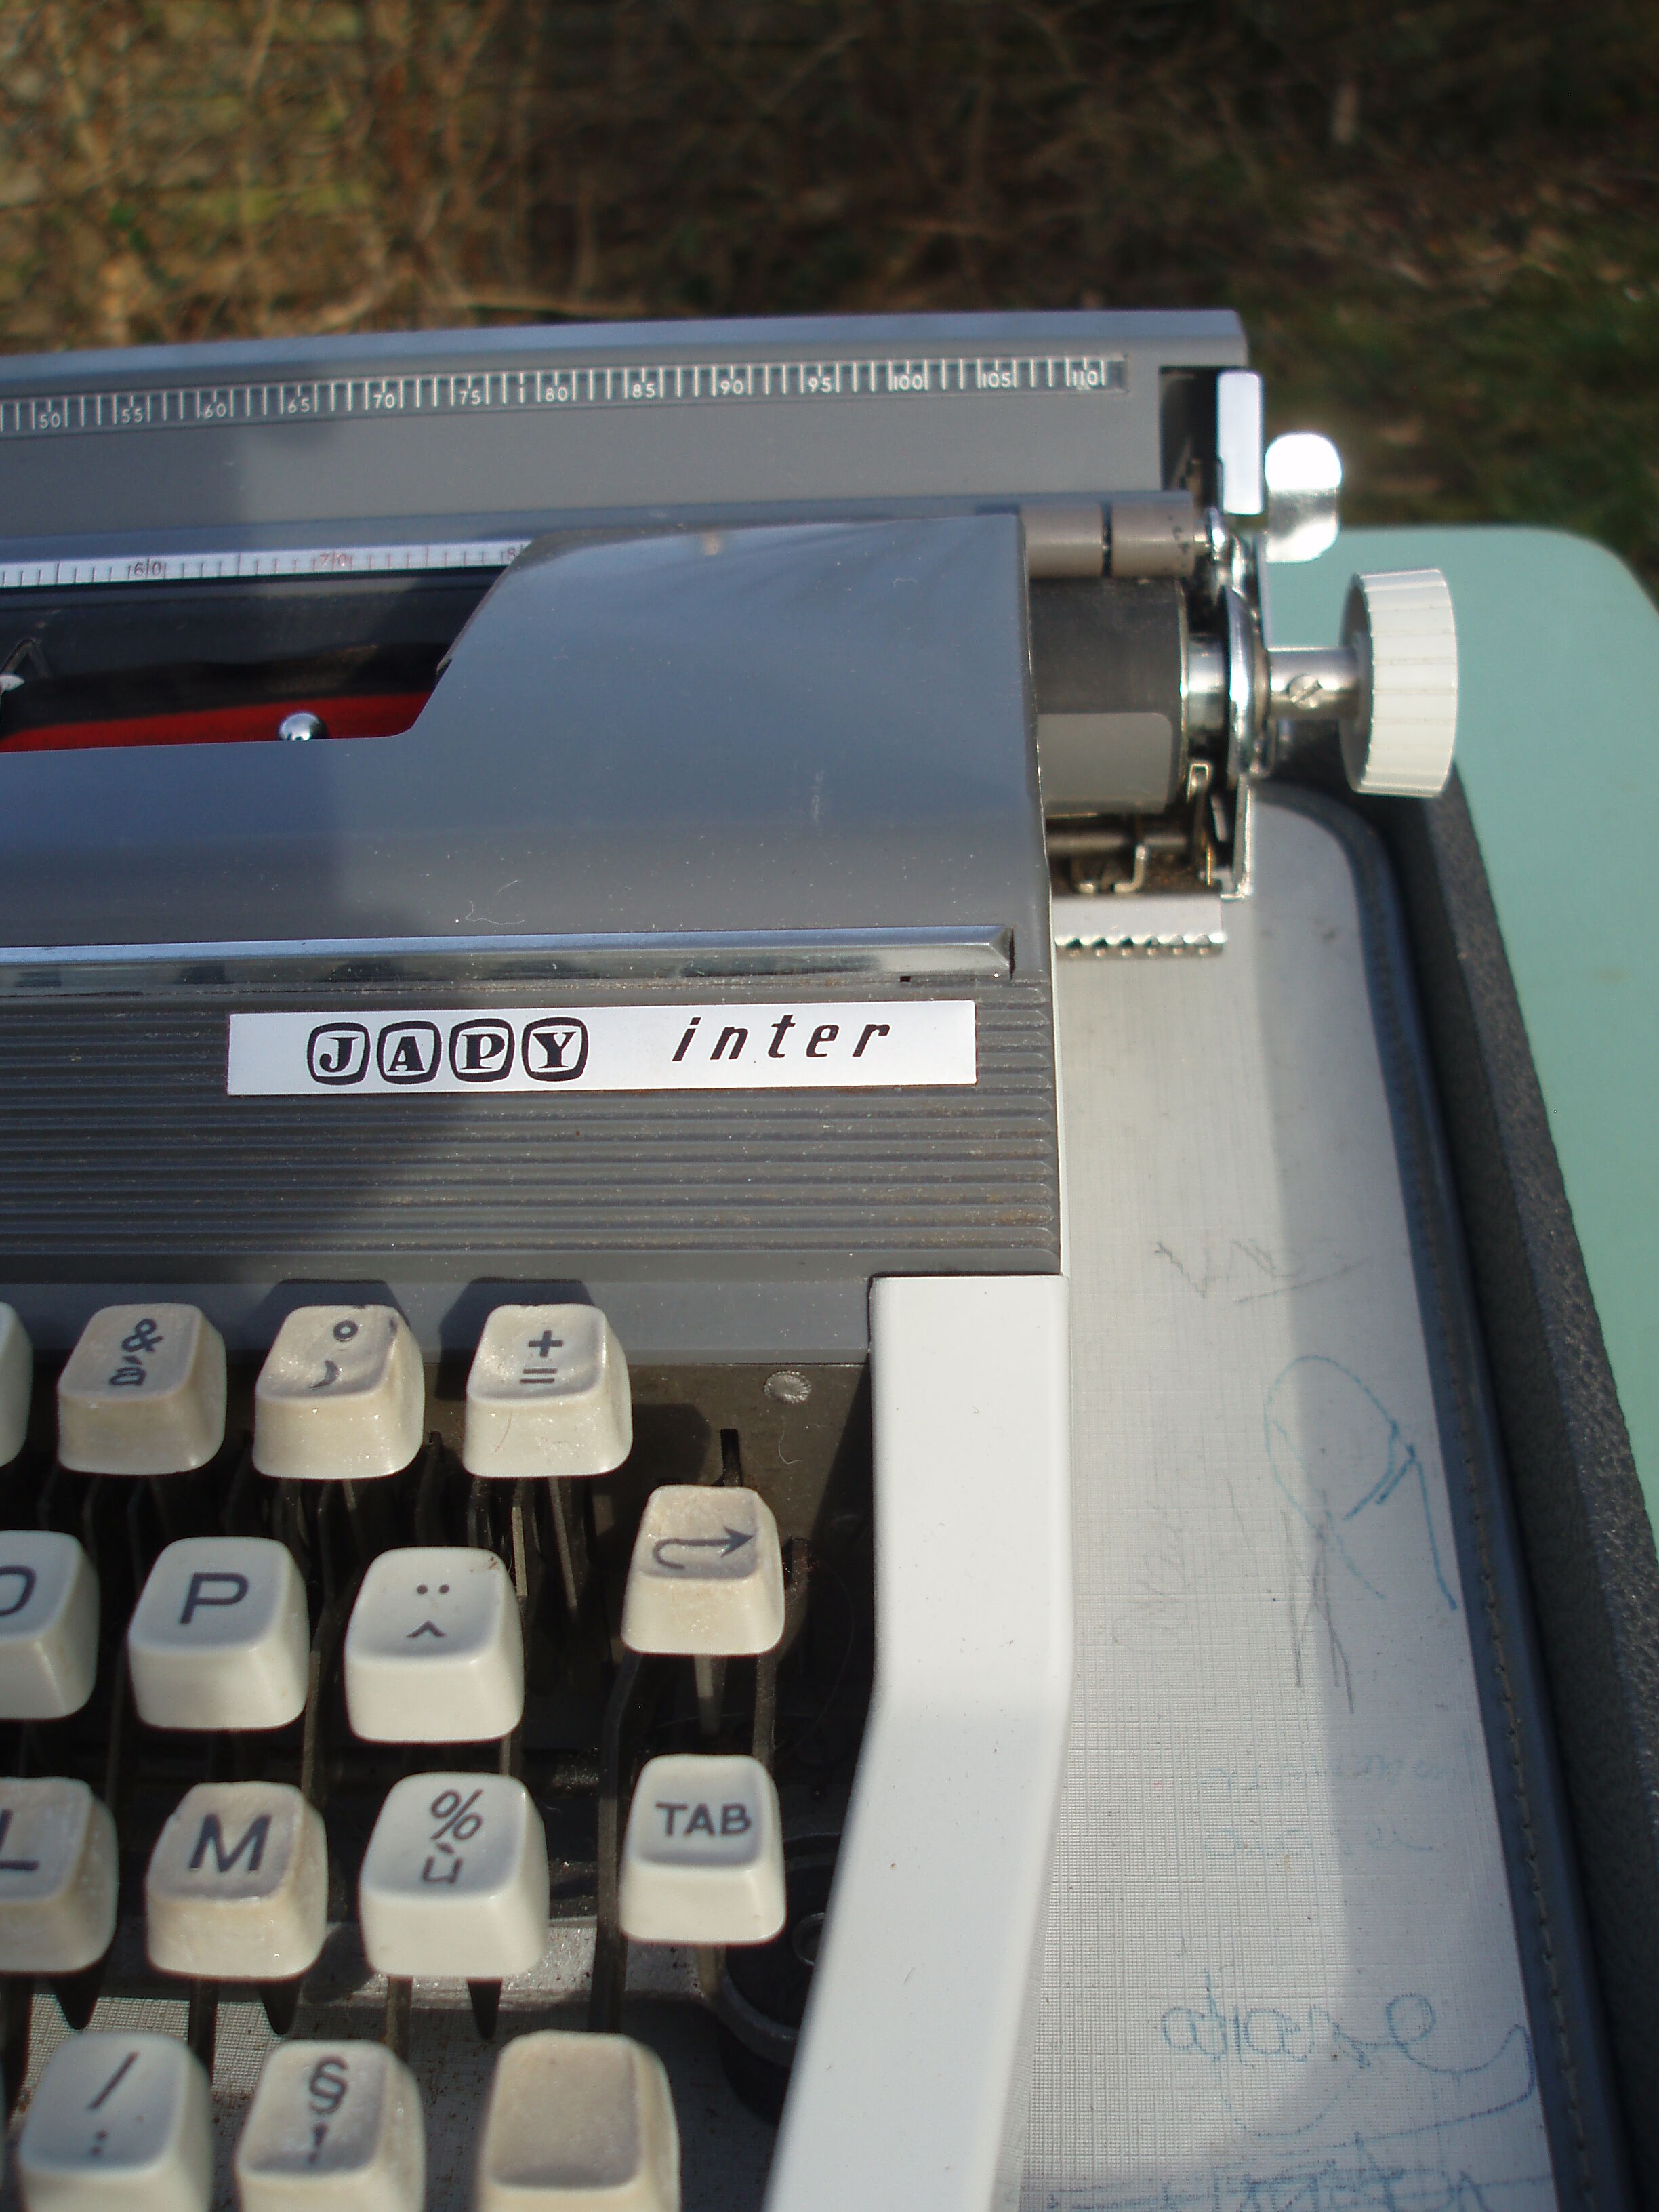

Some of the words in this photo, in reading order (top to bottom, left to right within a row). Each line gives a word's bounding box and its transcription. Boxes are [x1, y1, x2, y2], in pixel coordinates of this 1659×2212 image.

[39, 413, 61, 429] 50
[122, 408, 144, 424] 55
[204, 403, 226, 419] 60
[288, 398, 310, 414] 65
[373, 393, 395, 410] 70
[459, 389, 480, 406] 75
[546, 385, 568, 402] 80
[632, 382, 655, 398] 85
[720, 380, 743, 396] 90
[808, 376, 832, 393] 95
[893, 373, 923, 391] 100
[983, 371, 1011, 388] 105
[308, 1017, 588, 1084] JAPY
[671, 1015, 891, 1063] inter
[122, 1318, 163, 1352] &
[529, 1330, 564, 1358] +
[520, 1368, 558, 1385] =
[180, 1572, 249, 1625] P
[430, 1789, 483, 1840] %
[655, 1801, 752, 1839] TAB
[188, 1814, 271, 1873] M
[88, 2051, 139, 2110] /
[307, 2055, 350, 2114] §
